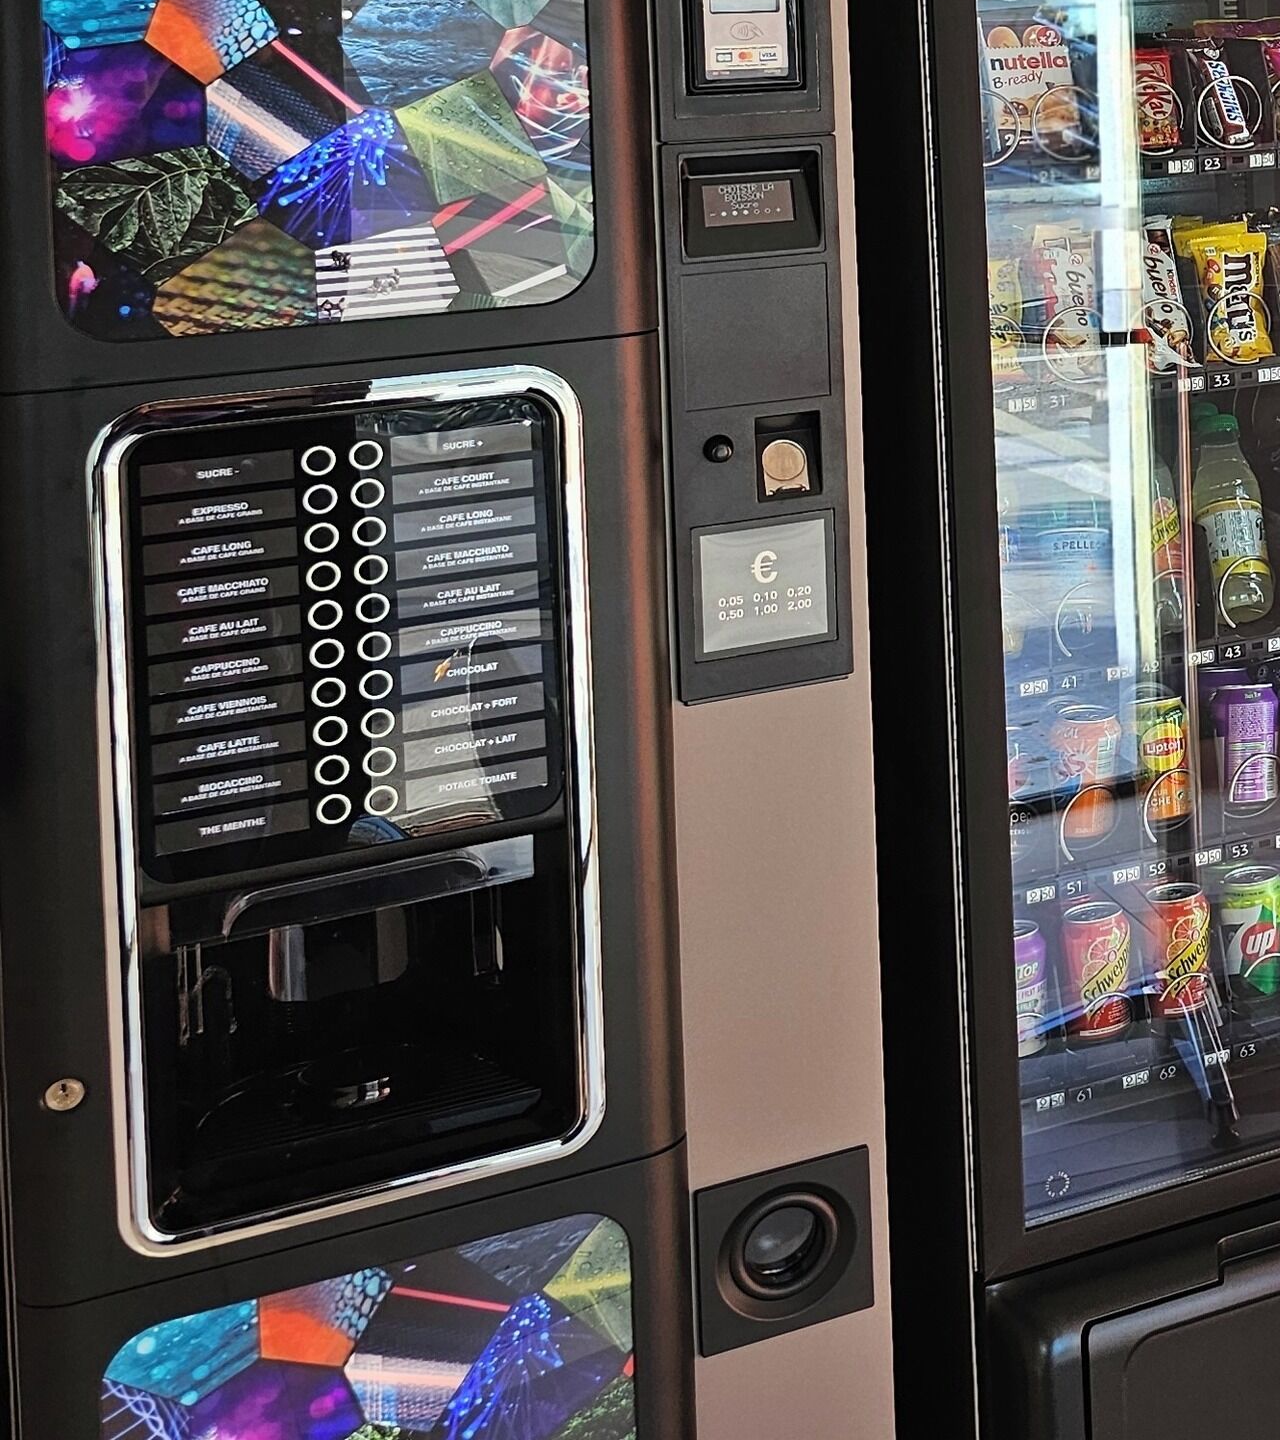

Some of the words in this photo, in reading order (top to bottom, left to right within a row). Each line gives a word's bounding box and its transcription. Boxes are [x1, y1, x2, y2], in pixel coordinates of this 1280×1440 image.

[990, 51, 1068, 71] nutella
[993, 70, 1043, 89] B-ready
[1136, 68, 1173, 120] KtKat
[1208, 60, 1245, 125] SNICKERS
[1204, 157, 1220, 171] 23
[718, 184, 758, 195] CHOISIR
[762, 182, 774, 192] LA
[725, 191, 764, 203] BOISSON
[1144, 256, 1173, 314] bueno
[1066, 270, 1089, 326] bueno
[1213, 374, 1231, 388] 33
[442, 439, 476, 450] SUCRE
[196, 467, 234, 479] SUCRE
[434, 475, 460, 486] CAFE
[461, 471, 495, 483] COURT
[191, 502, 249, 517] EXPRESSO
[439, 512, 465, 524] CAFE
[466, 509, 494, 521] LONG
[190, 544, 221, 556] CAFE
[222, 541, 252, 552] LONG
[426, 552, 453, 563] CAFE
[453, 544, 510, 559] MACCHIATO
[751, 550, 778, 584] €
[177, 584, 207, 597] CAFE
[207, 577, 269, 594] MACCHIATO
[437, 588, 463, 600] CAFE
[464, 585, 478, 596] AU
[479, 582, 501, 594] LAIT
[718, 595, 744, 608] 0,05
[753, 590, 778, 603] 0,10
[787, 585, 812, 598] 0,20
[718, 609, 744, 621] 0,50
[754, 603, 778, 616] 1,00
[787, 598, 812, 611] 2,00
[188, 623, 219, 636] CAFE
[219, 620, 235, 632] AU
[236, 617, 260, 630] LAIT
[440, 620, 503, 638] CAPPUCCINO
[1224, 645, 1241, 659] 43
[190, 656, 261, 675] CAPPUCCINO
[446, 662, 499, 678] CHOCOLAT
[1143, 661, 1160, 674] 42
[1061, 675, 1077, 690] 41
[187, 702, 217, 716] CAFE
[217, 695, 267, 712] VIENNOIS
[431, 703, 484, 719] CHOCOLAT
[492, 696, 518, 709] FORT
[196, 741, 227, 755] CAFE
[227, 735, 261, 749] LATTE
[435, 739, 487, 755] CHOCOLAT
[495, 733, 518, 745] LAIT
[198, 774, 264, 793] MOCACCINO
[438, 779, 478, 793] POTAGE
[478, 771, 518, 786] TOMATE
[199, 825, 222, 837] THE
[222, 816, 267, 833] MENTHE
[1232, 844, 1249, 858] 53
[1149, 863, 1166, 877] 52
[1066, 880, 1082, 895] 51
[1239, 1044, 1256, 1058] 63
[1159, 1065, 1177, 1081] 62
[1076, 1087, 1093, 1103] 61
